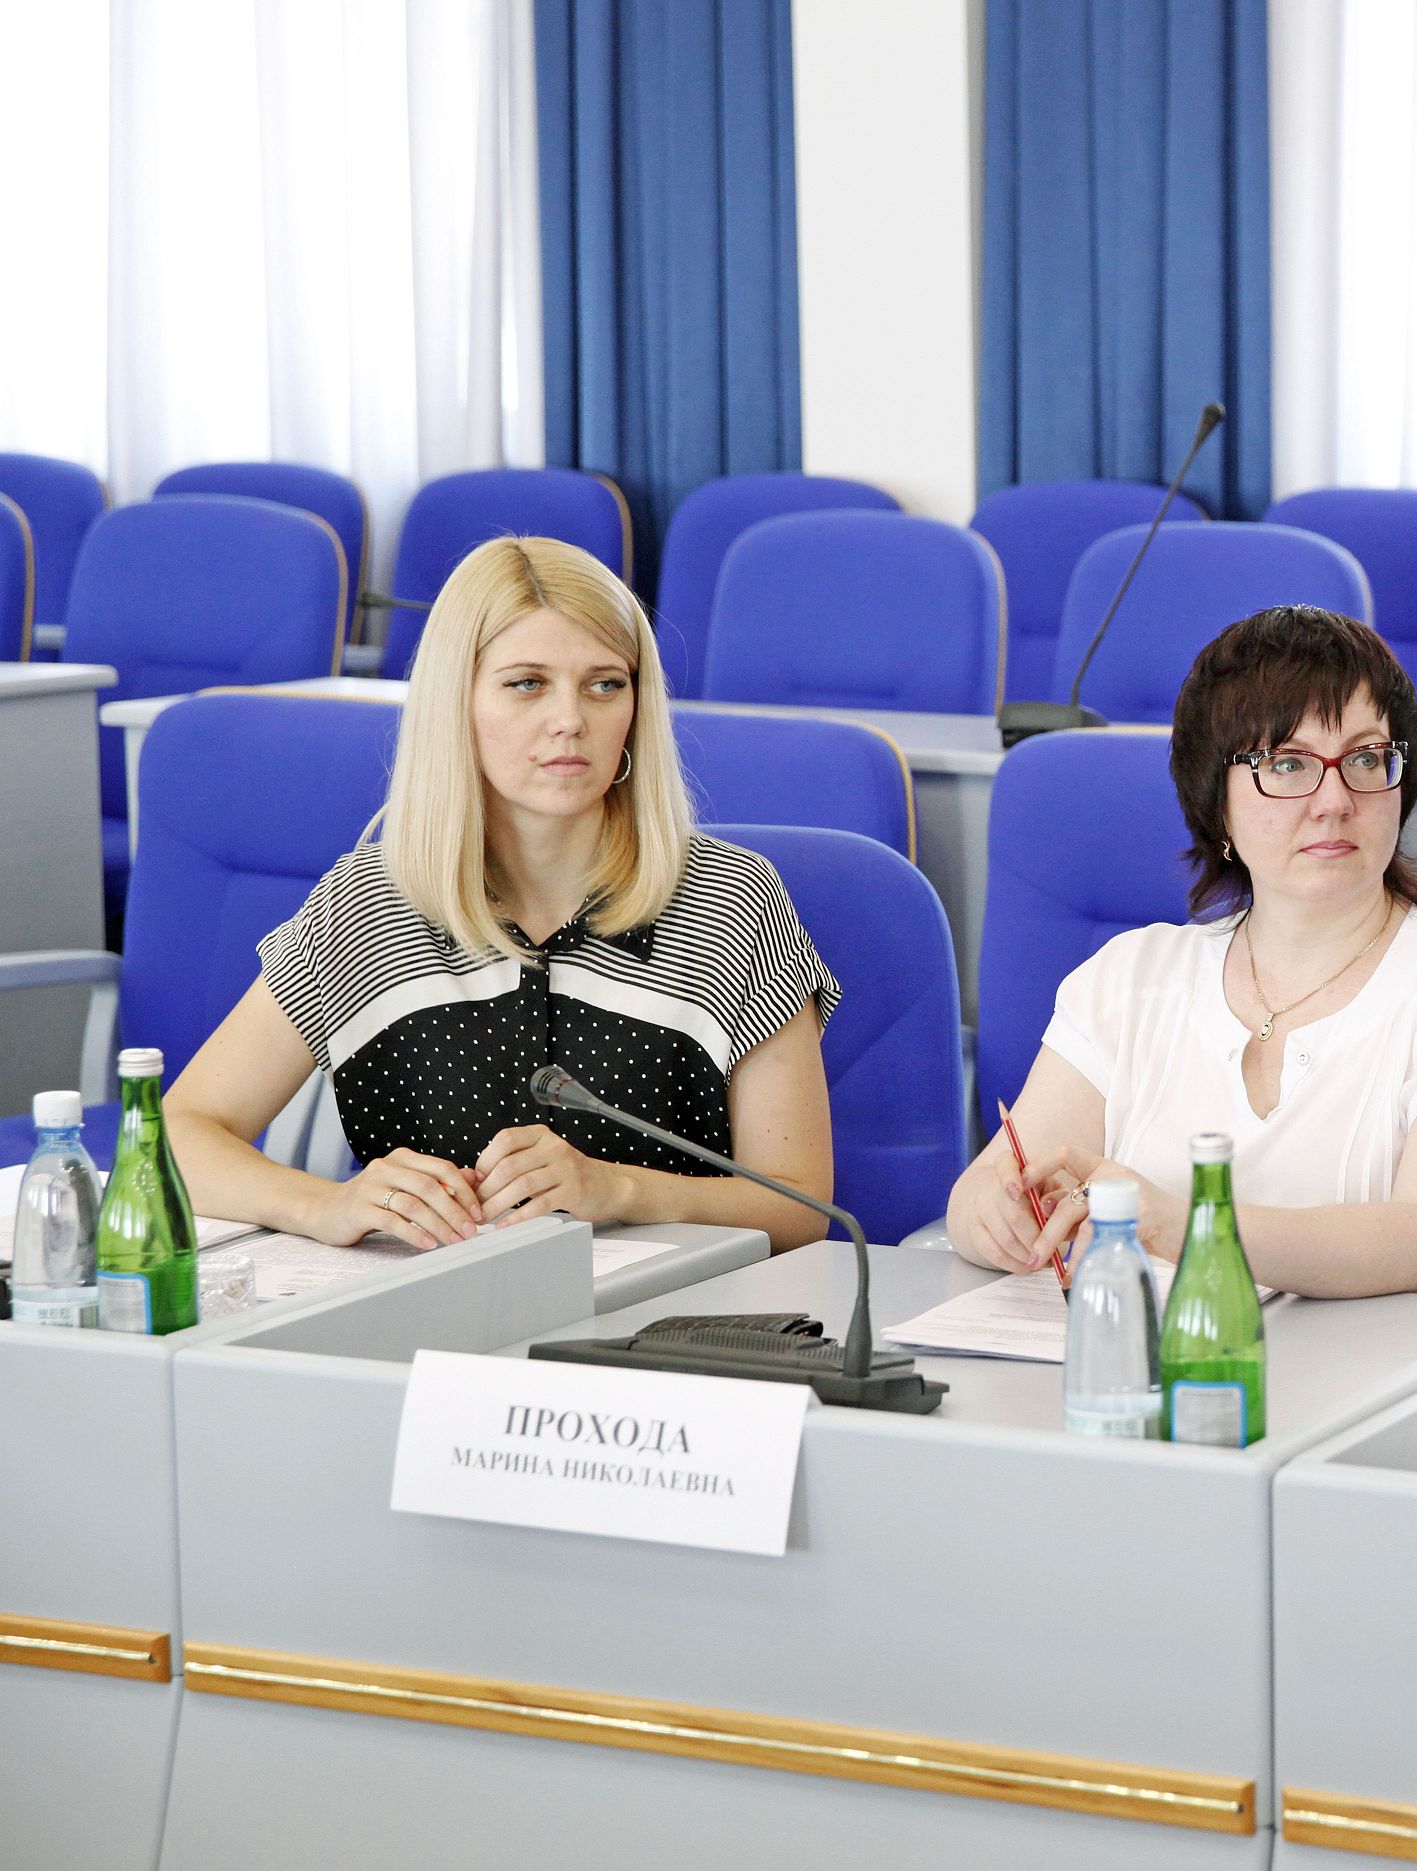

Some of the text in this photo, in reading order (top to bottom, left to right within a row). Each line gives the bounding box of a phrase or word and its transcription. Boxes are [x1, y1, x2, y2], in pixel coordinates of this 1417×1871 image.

[503, 1404, 690, 1456] ПРОХОДА
[451, 1446, 736, 1496] МАРИНА НИКОЛАЕВНА
